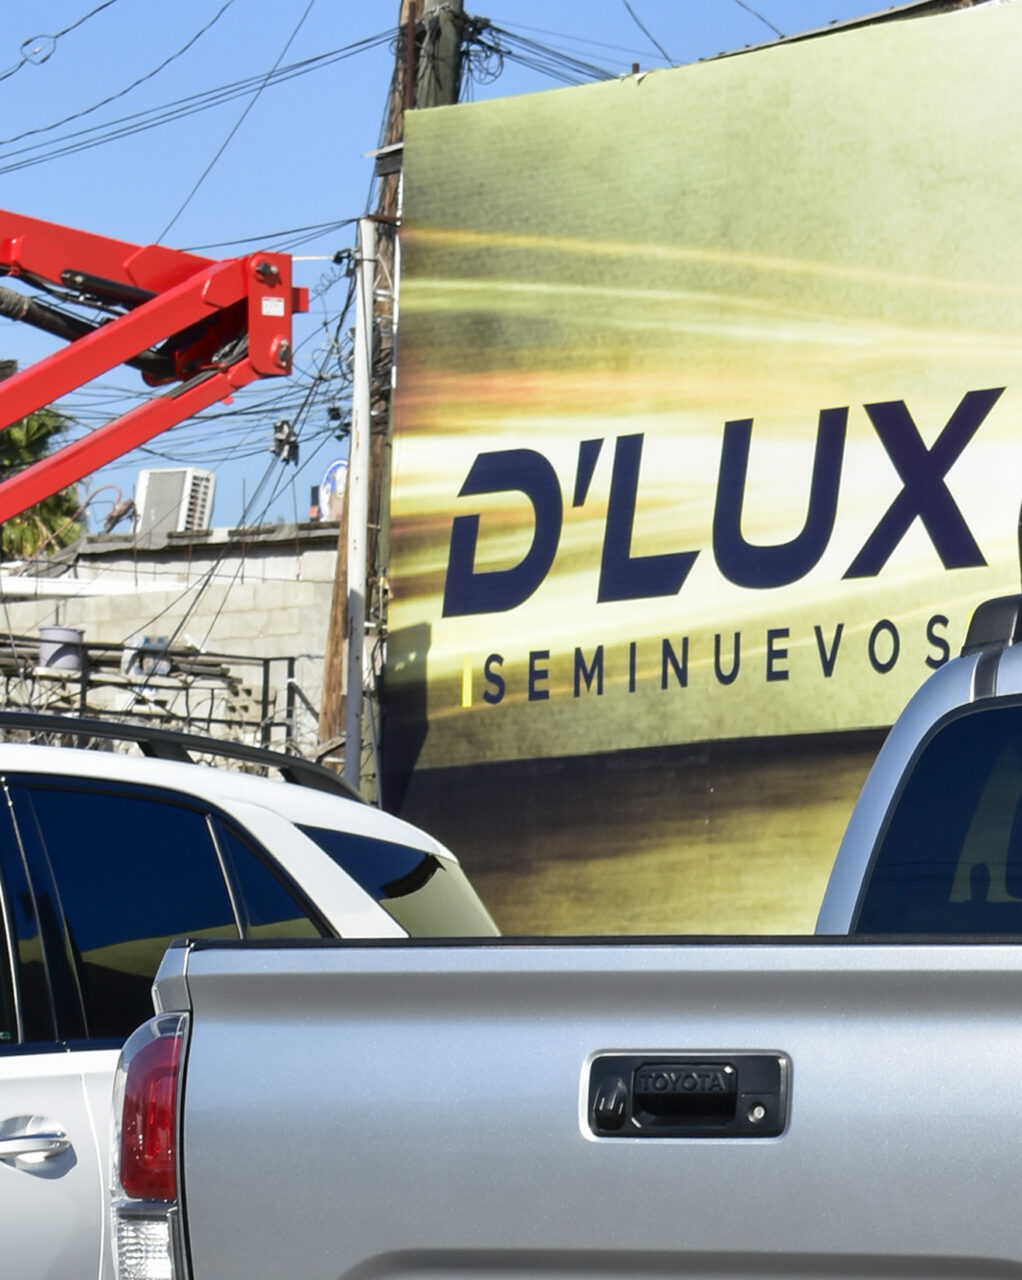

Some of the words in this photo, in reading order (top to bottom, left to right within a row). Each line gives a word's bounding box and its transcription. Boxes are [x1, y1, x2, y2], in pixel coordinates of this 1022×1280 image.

[442, 386, 1007, 618] D'LUX
[483, 614, 950, 704] SEMINUEVOS
[639, 1071, 726, 1091] TOYOTA
